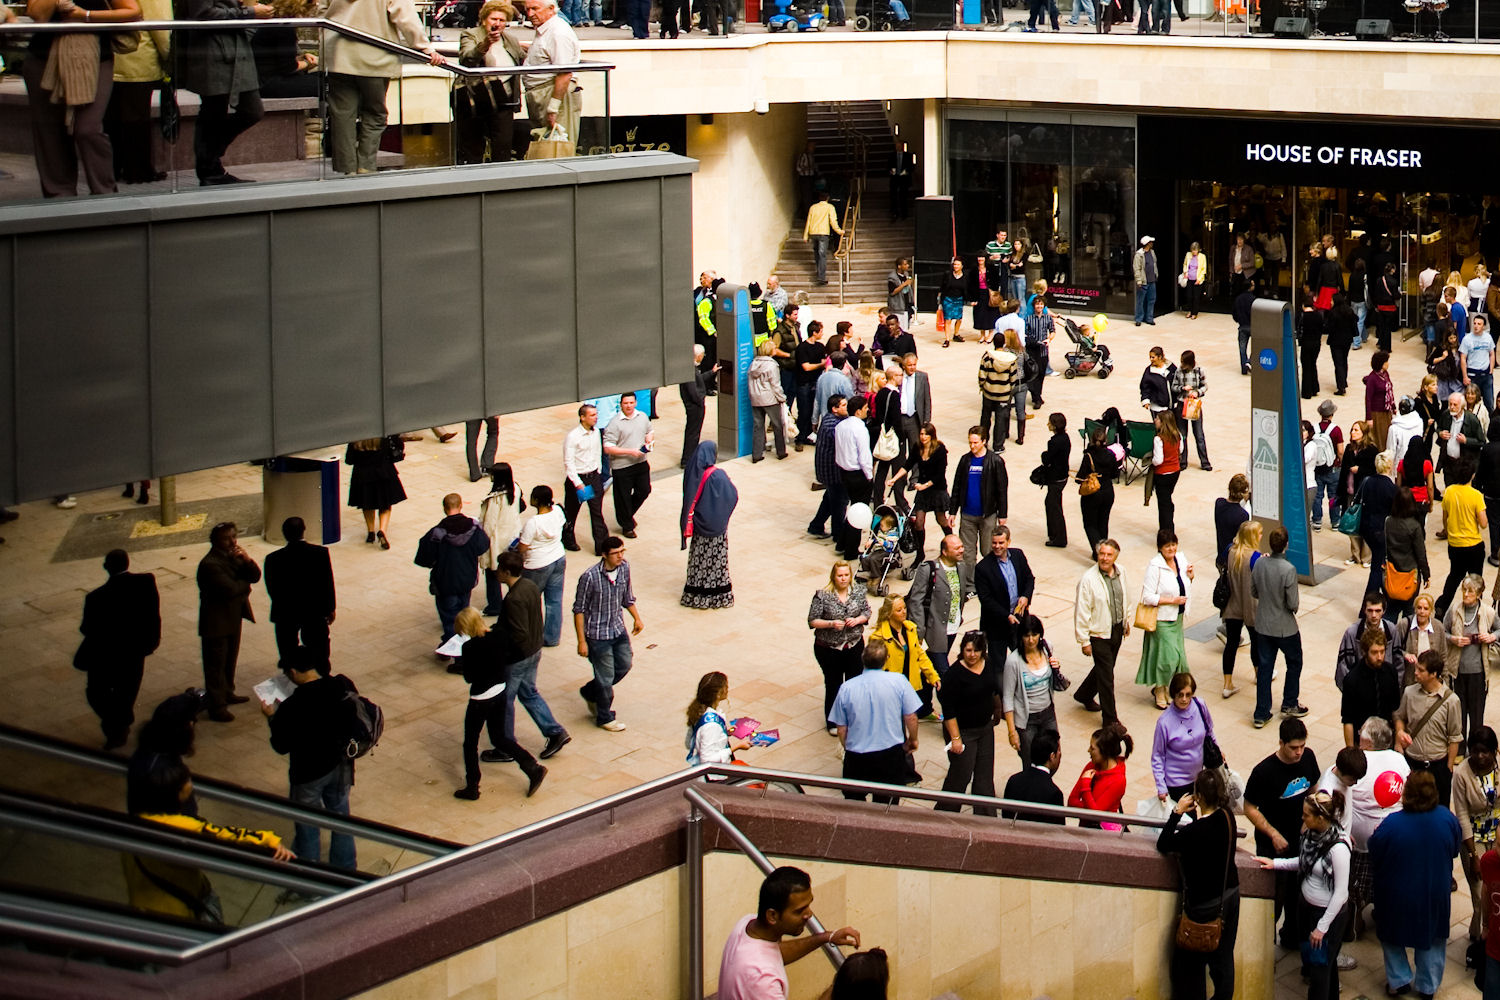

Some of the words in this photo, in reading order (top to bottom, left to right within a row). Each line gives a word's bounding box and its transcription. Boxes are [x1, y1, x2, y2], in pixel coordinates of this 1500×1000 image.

[1246, 143, 1312, 163] HOUSE
[1317, 146, 1344, 165] OF
[1350, 147, 1422, 168] FRASER
